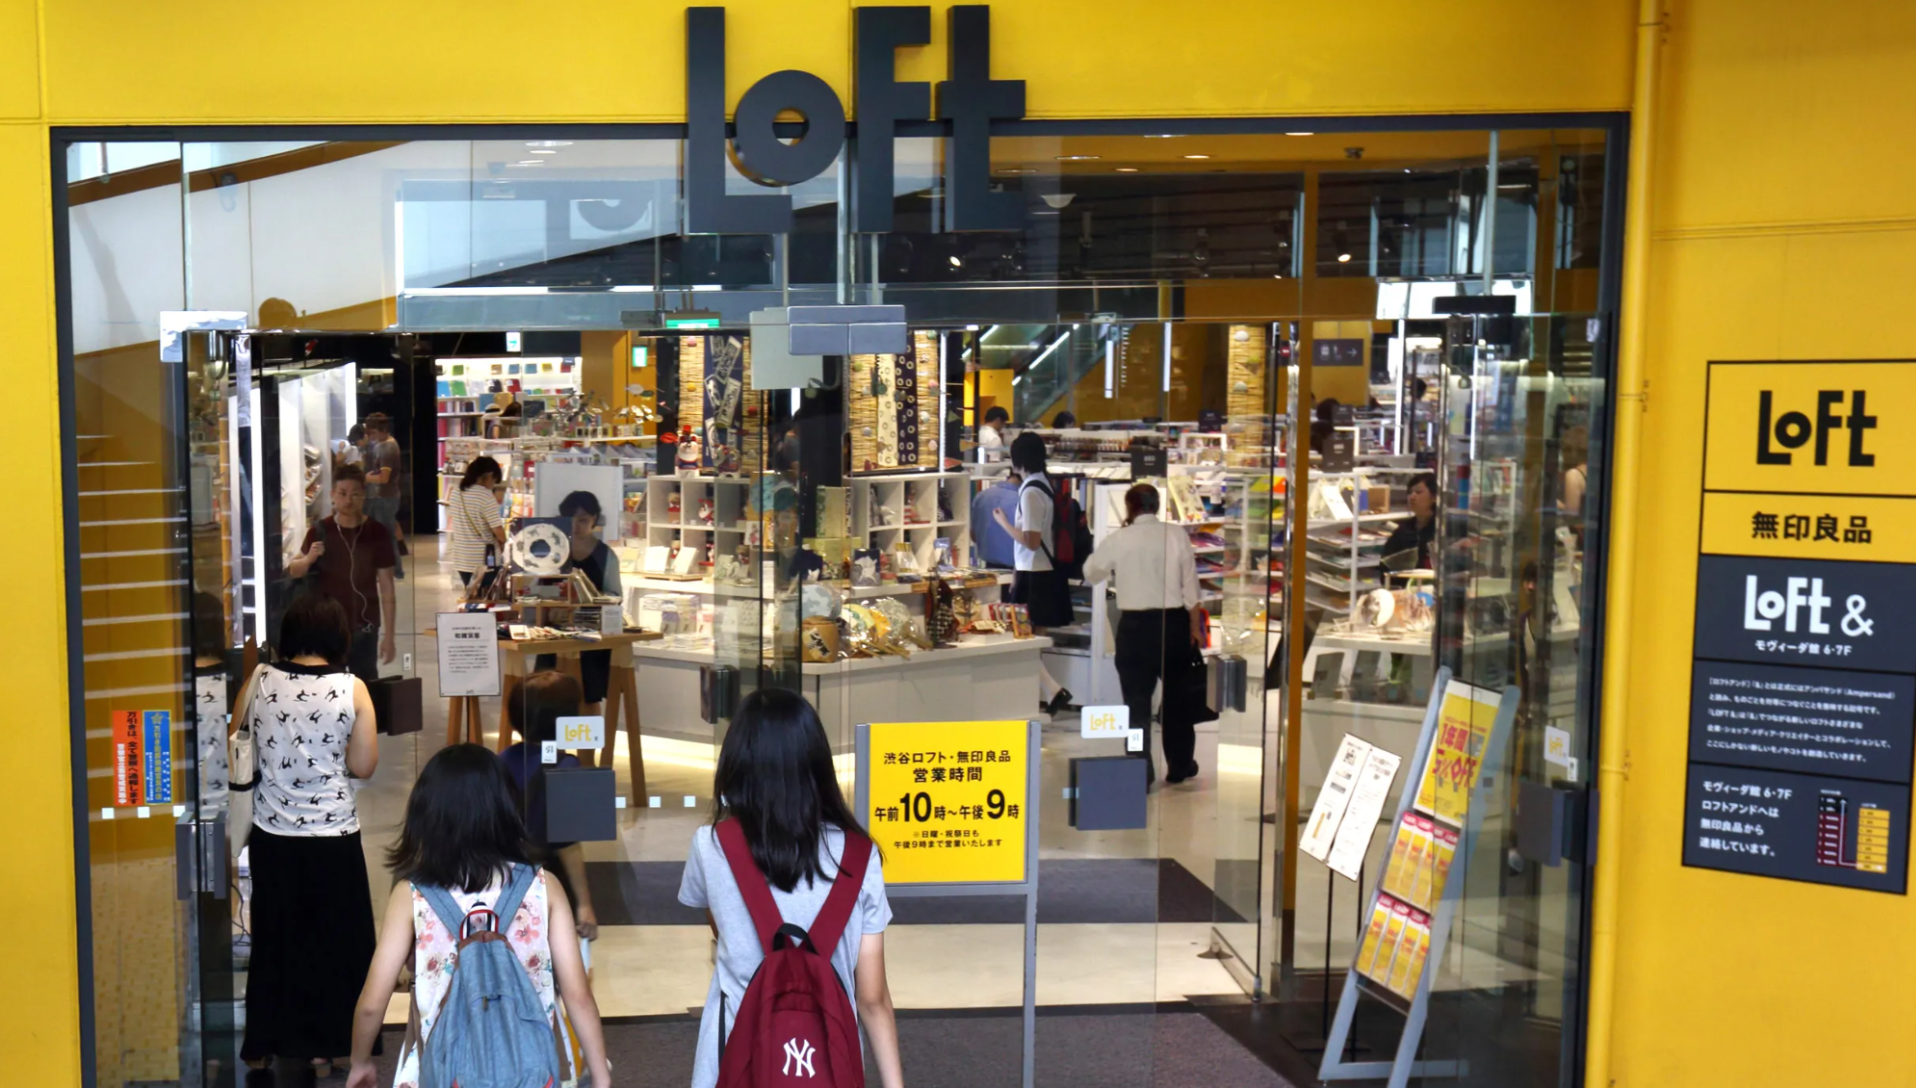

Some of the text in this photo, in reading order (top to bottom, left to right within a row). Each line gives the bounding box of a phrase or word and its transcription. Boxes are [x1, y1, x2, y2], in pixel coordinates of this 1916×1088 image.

[1751, 511, 1872, 544] 無印良品
[1841, 594, 1875, 637] &
[884, 750, 1012, 765] 渋谷ロフト・無印良品
[913, 767, 983, 783] 営業時間
[1702, 799, 1780, 819] ロフトアンドへは
[1701, 817, 1765, 836] 無印良品から
[894, 839, 1003, 850] 午後9時まで営業いたします
